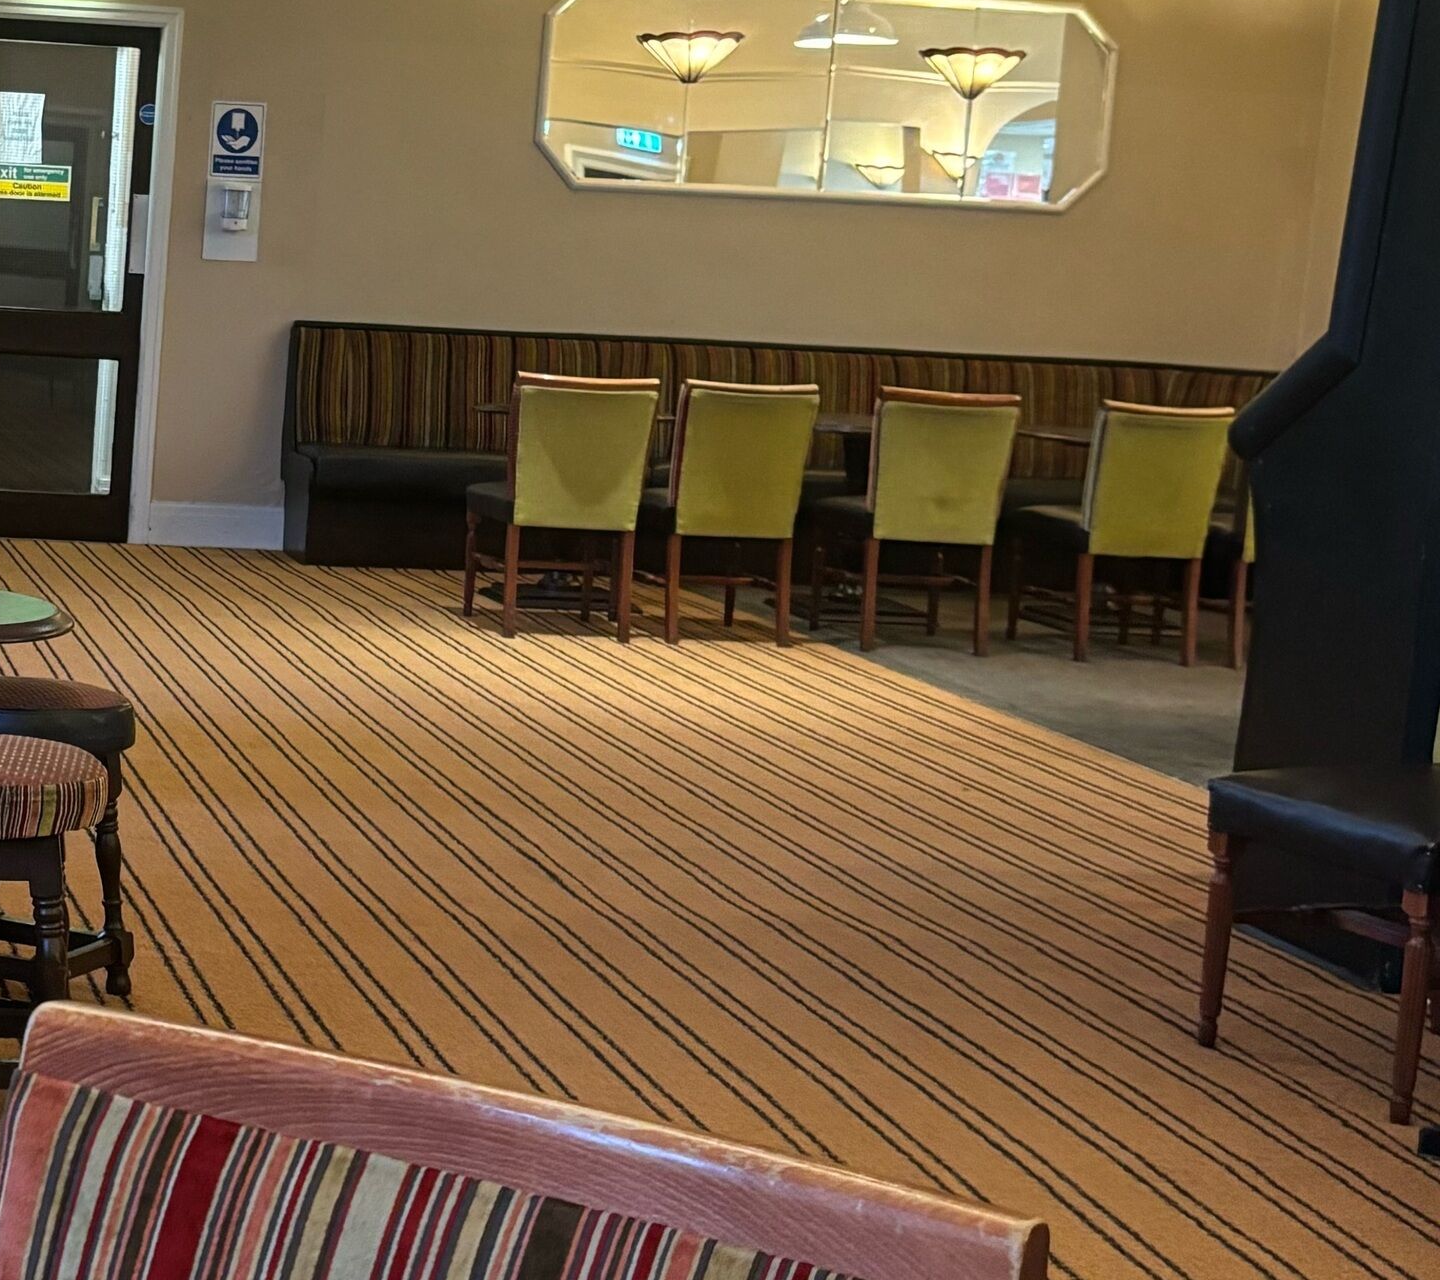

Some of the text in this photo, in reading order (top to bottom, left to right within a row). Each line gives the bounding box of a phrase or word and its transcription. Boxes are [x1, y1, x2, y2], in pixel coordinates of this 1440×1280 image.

[33, 168, 65, 176] emergency
[12, 182, 42, 191] Caution
[9, 189, 26, 197] door
